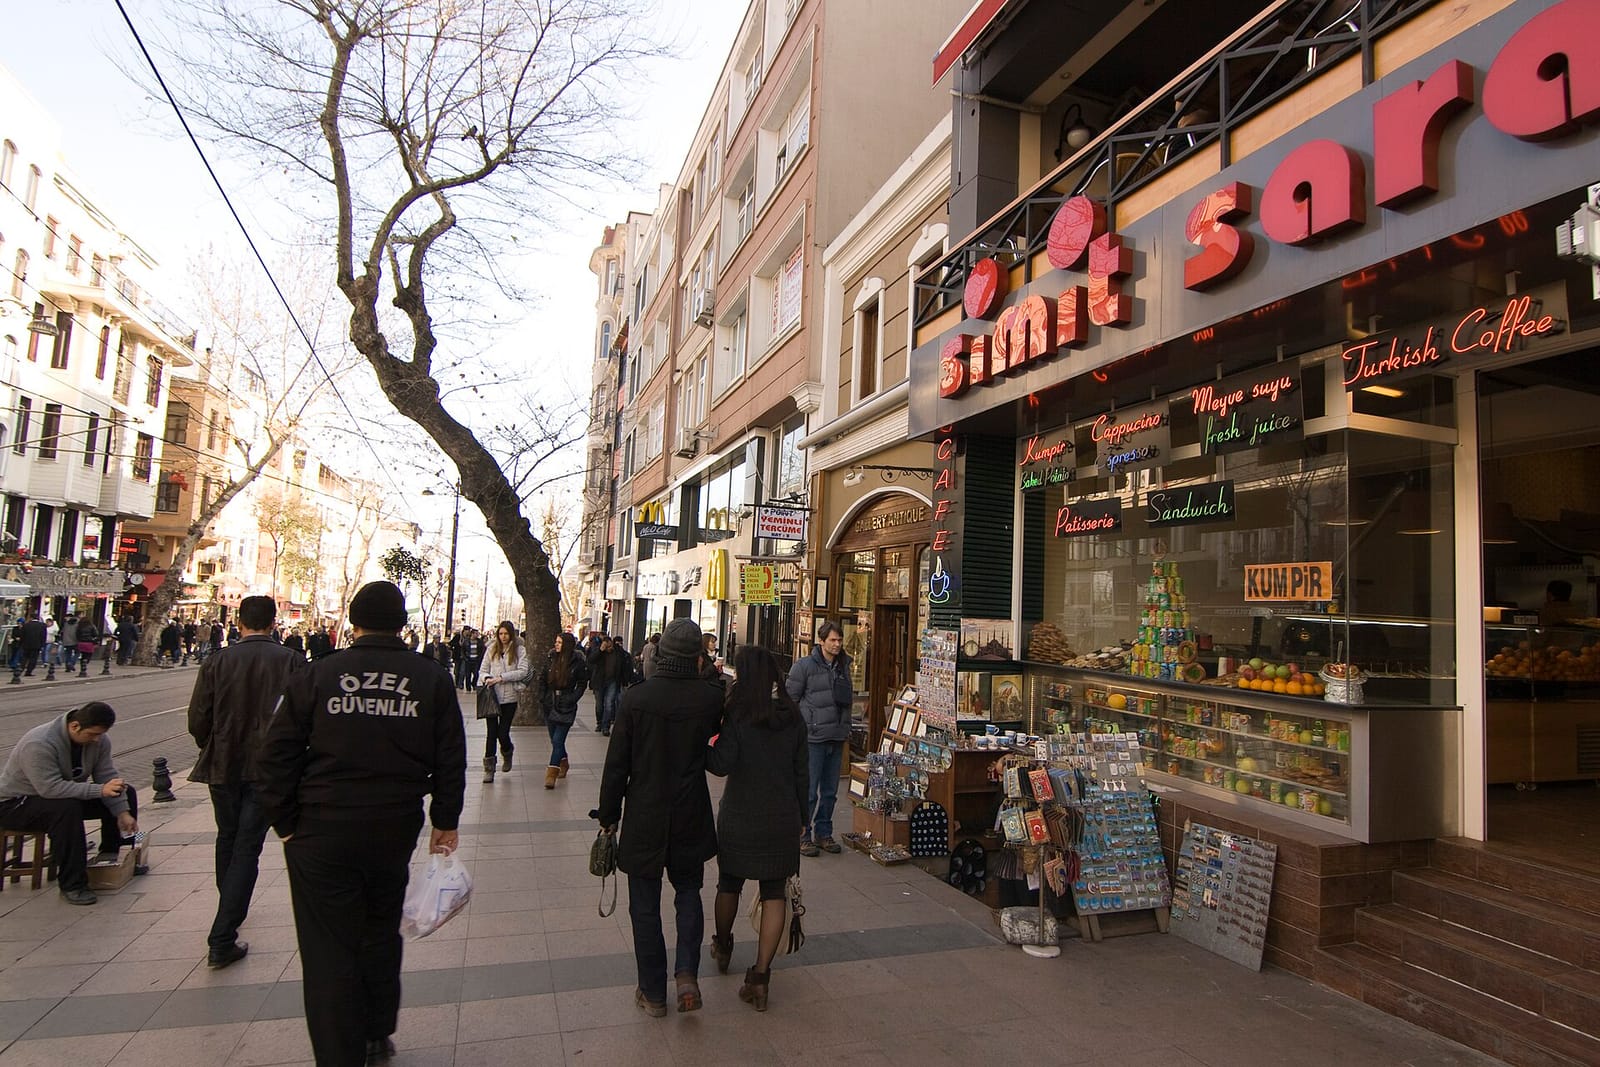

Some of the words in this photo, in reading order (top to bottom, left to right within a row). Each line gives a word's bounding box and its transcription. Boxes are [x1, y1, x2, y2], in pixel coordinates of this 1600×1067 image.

[939, 195, 1134, 398] simit
[1341, 326, 1440, 385] Turkish
[1451, 295, 1553, 353] Coffee
[1191, 386, 1244, 416] Meyve
[1252, 376, 1292, 401] suyu
[1091, 412, 1162, 444] Cappucino
[1204, 411, 1241, 455] fresh
[1249, 413, 1291, 446] juice
[1019, 434, 1067, 467] Kumpir
[933, 437, 953, 552] CAFE
[1144, 485, 1229, 523] Sandwich
[887, 506, 925, 527] ANTIQUE
[1053, 505, 1115, 537] Patisserie
[339, 671, 411, 697] ÖZEL
[326, 692, 420, 717] GÜVENLİK
